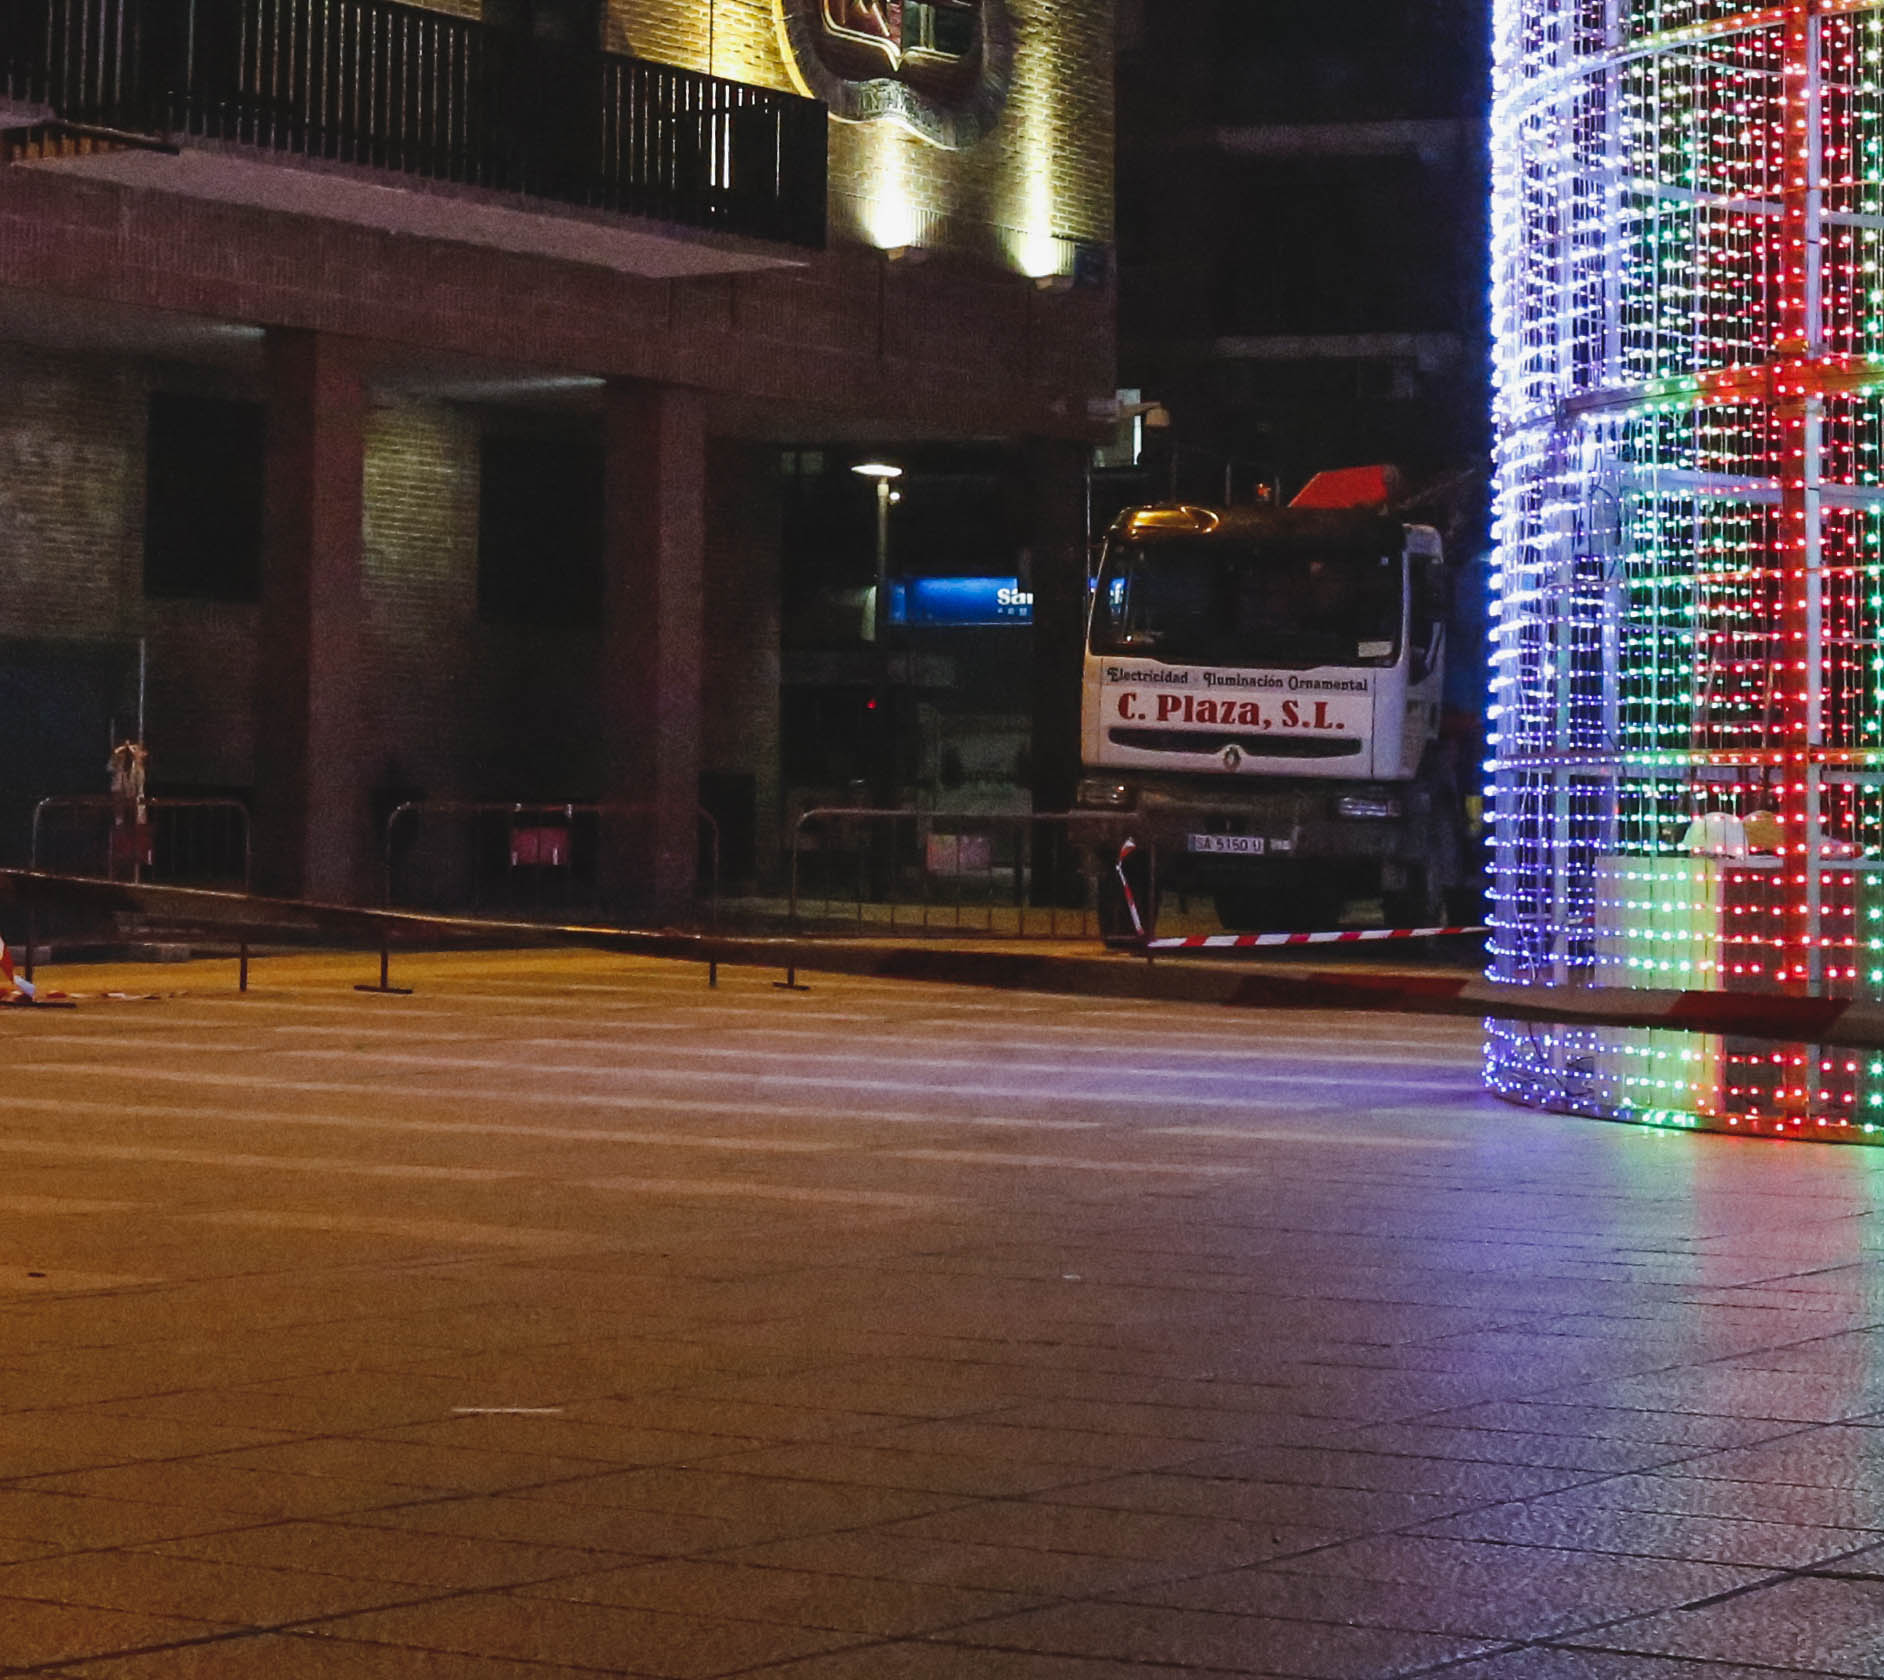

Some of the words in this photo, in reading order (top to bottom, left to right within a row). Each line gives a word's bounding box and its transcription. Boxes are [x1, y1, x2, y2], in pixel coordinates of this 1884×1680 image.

[1107, 667, 1188, 683] Electricidad
[1288, 676, 1368, 691] Ornamental
[1118, 692, 1146, 720] C.
[1156, 694, 1272, 730] Plaza,
[1282, 700, 1345, 730] S.L.
